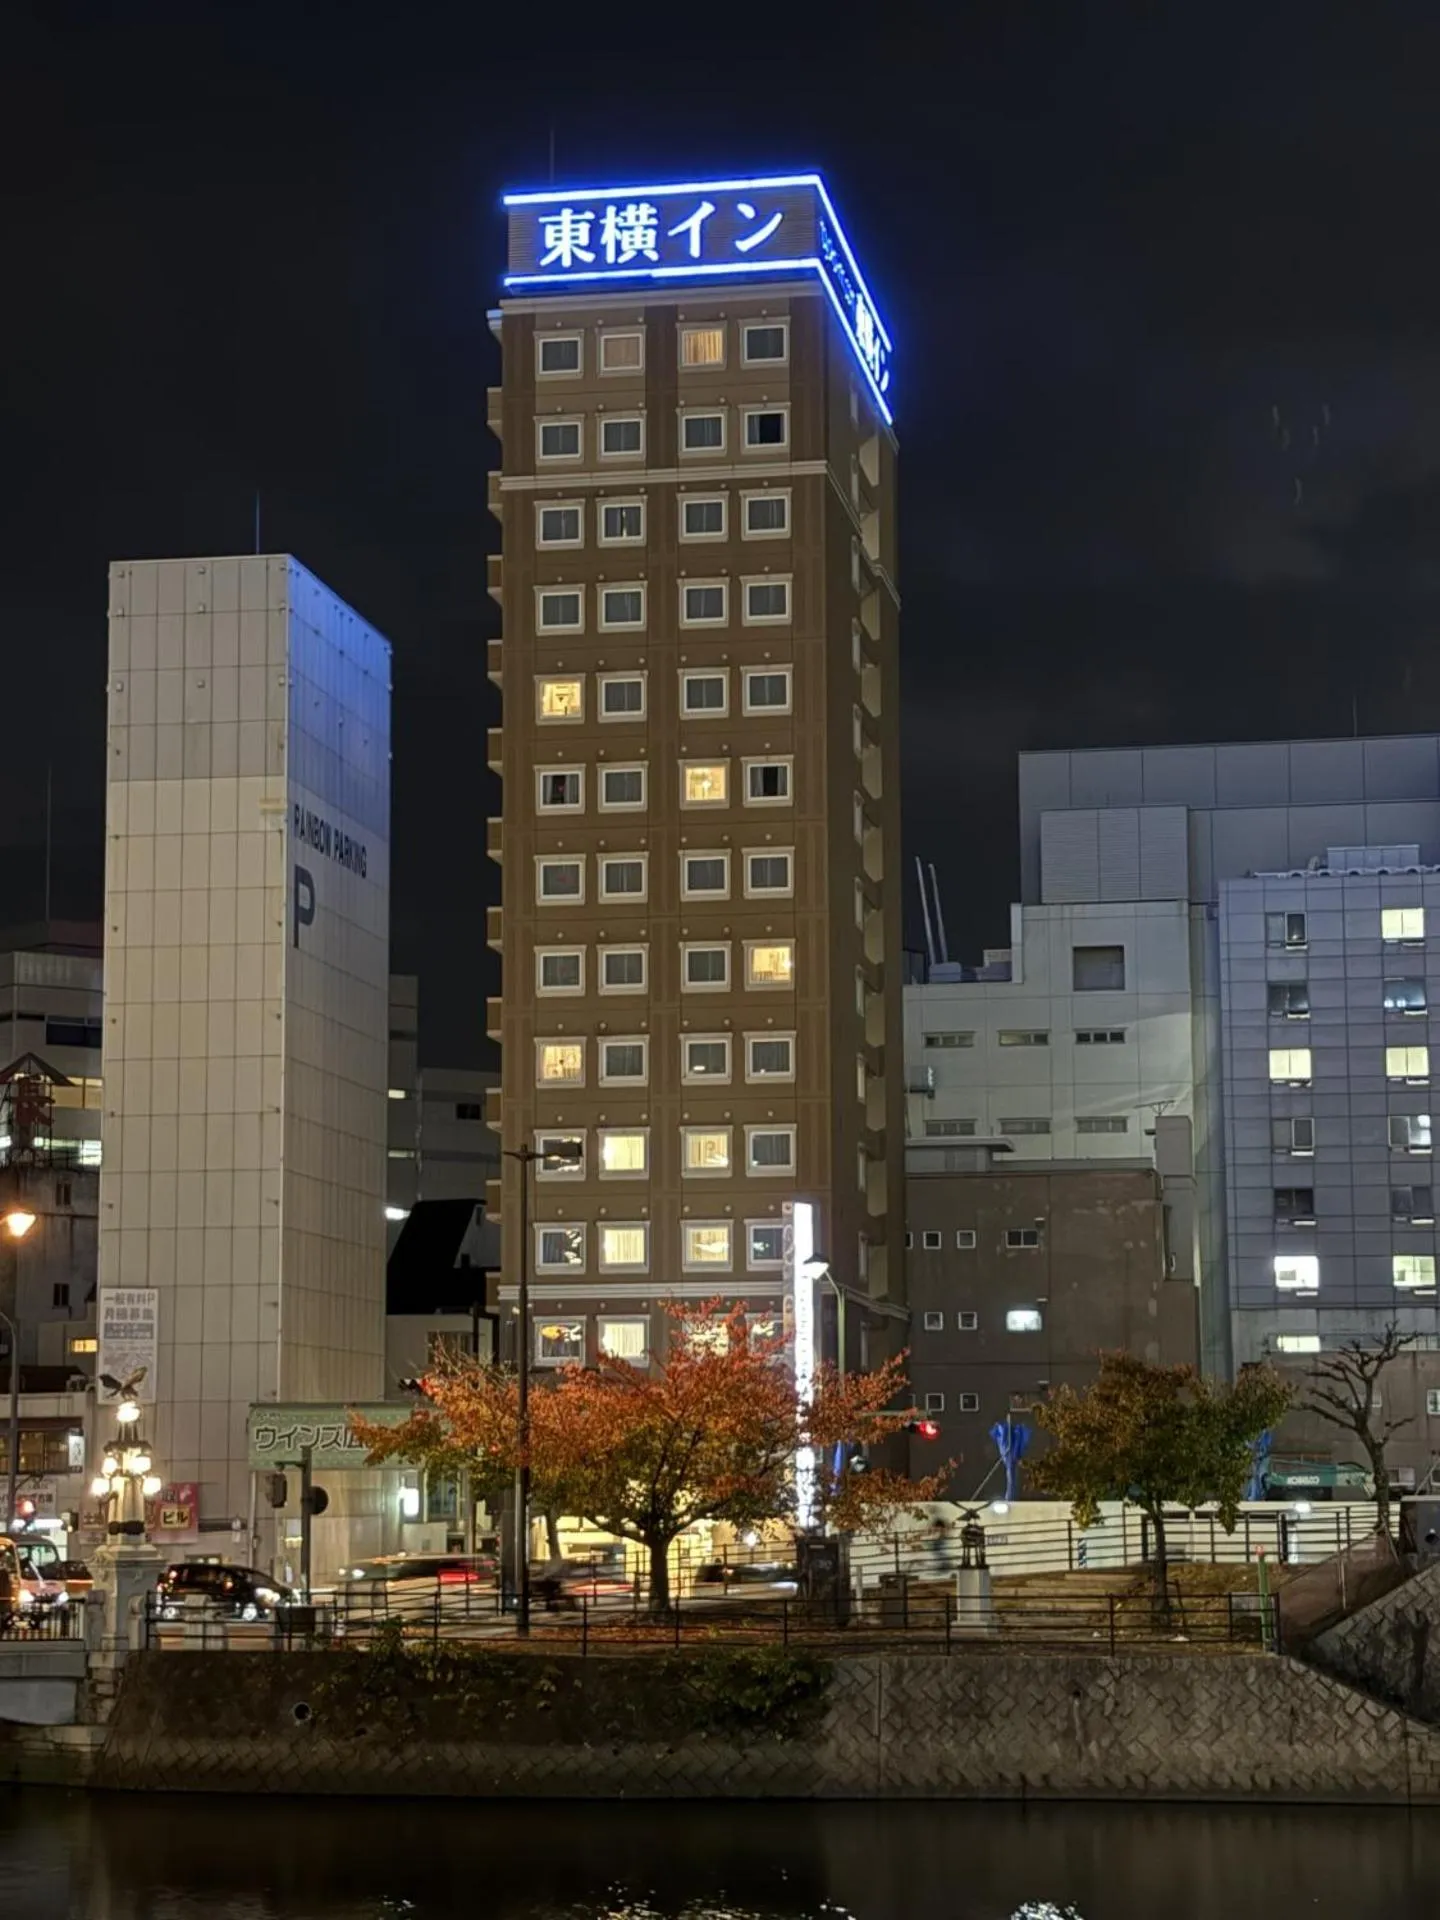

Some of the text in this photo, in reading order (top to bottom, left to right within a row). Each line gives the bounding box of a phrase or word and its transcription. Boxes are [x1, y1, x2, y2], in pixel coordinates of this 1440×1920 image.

[537, 201, 784, 267] 東横イン
[293, 864, 316, 948] P
